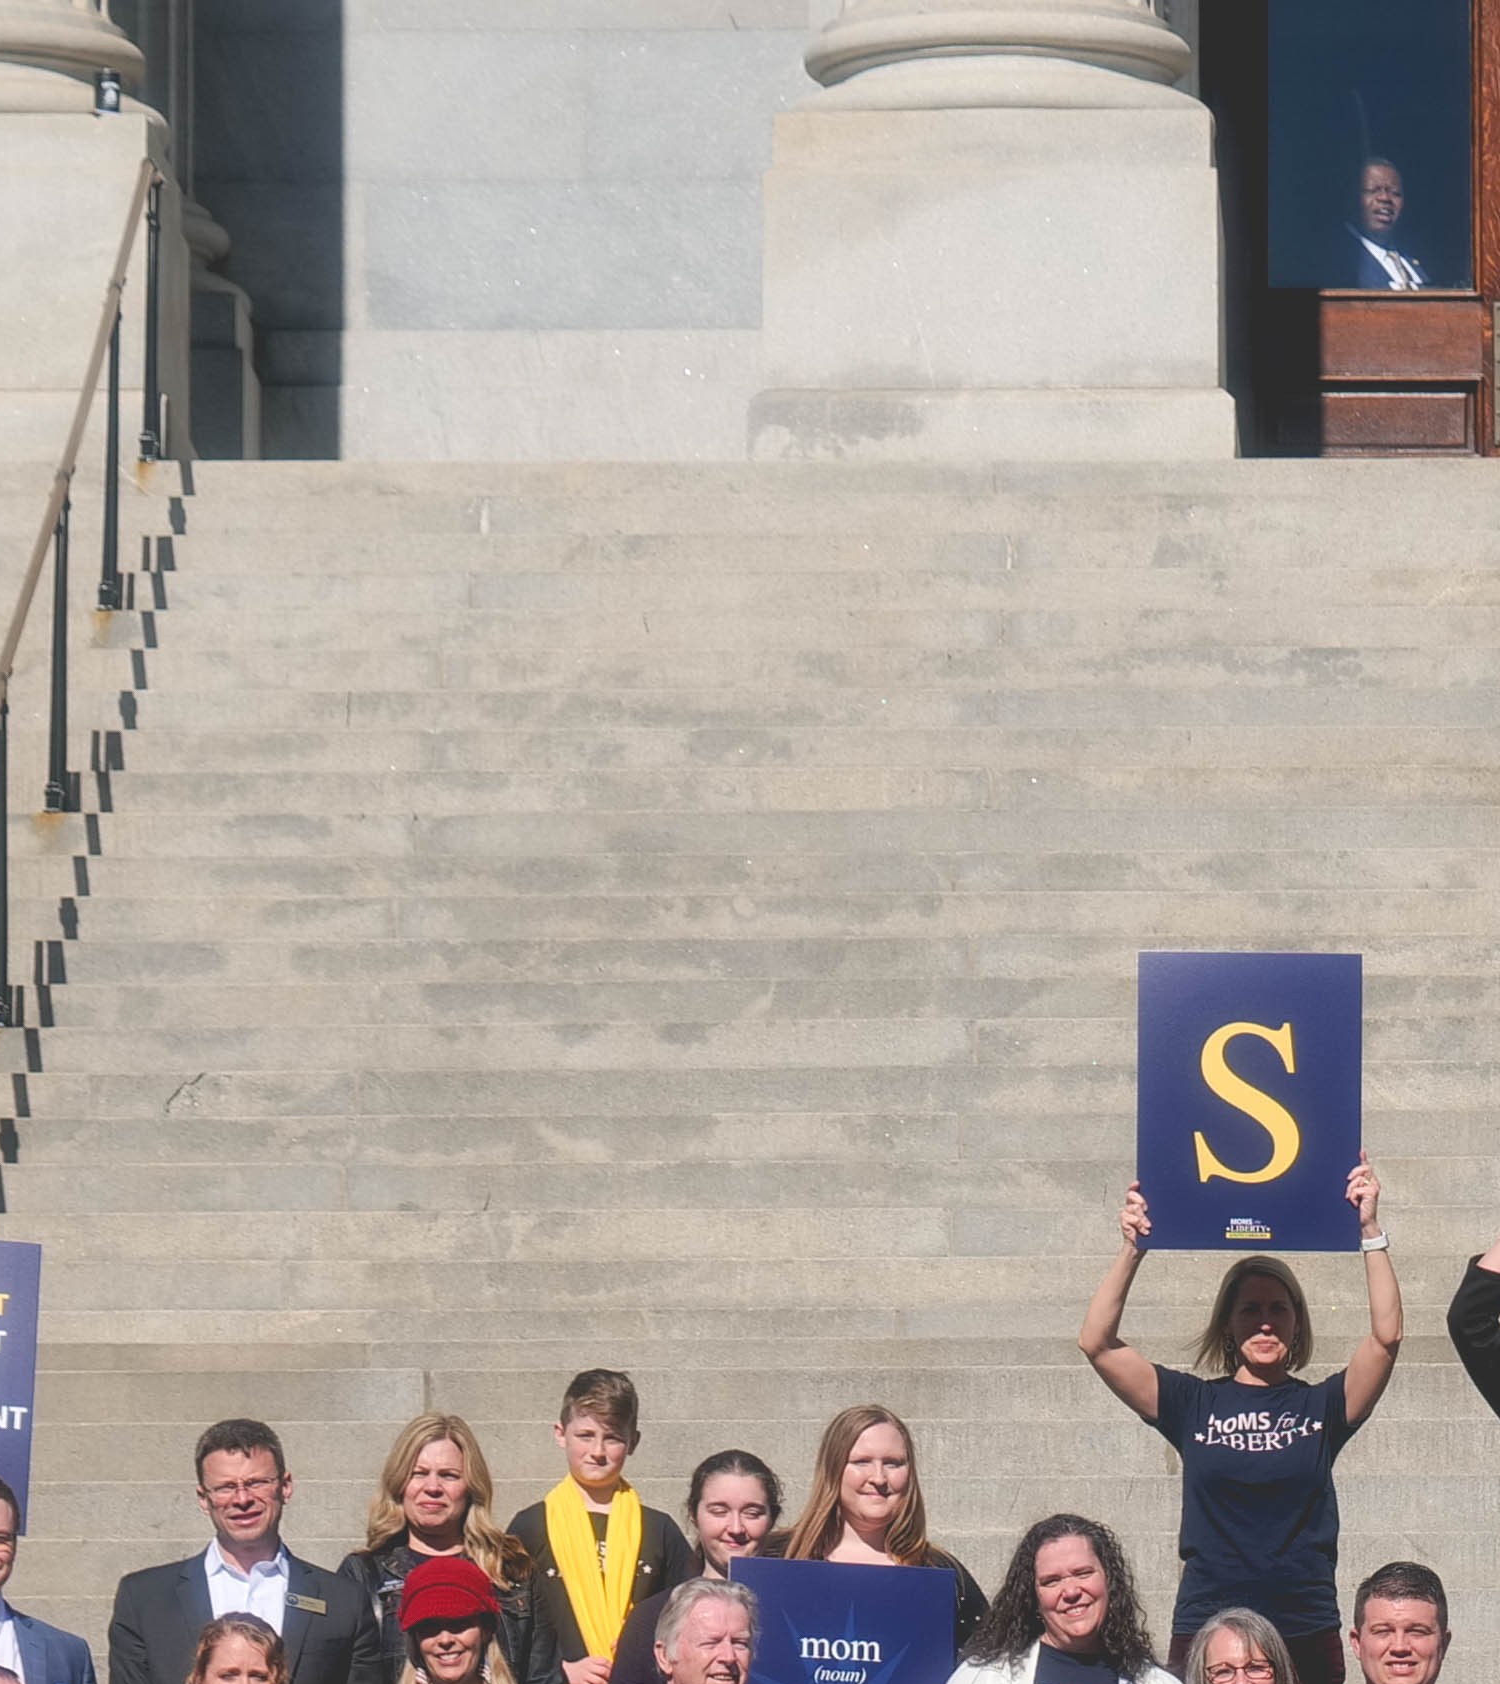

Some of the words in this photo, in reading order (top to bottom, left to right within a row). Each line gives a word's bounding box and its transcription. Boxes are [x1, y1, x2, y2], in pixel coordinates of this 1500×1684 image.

[1194, 1021, 1300, 1183] S
[1205, 1417, 1312, 1451] LIBERTY
[800, 1637, 881, 1662] mom
